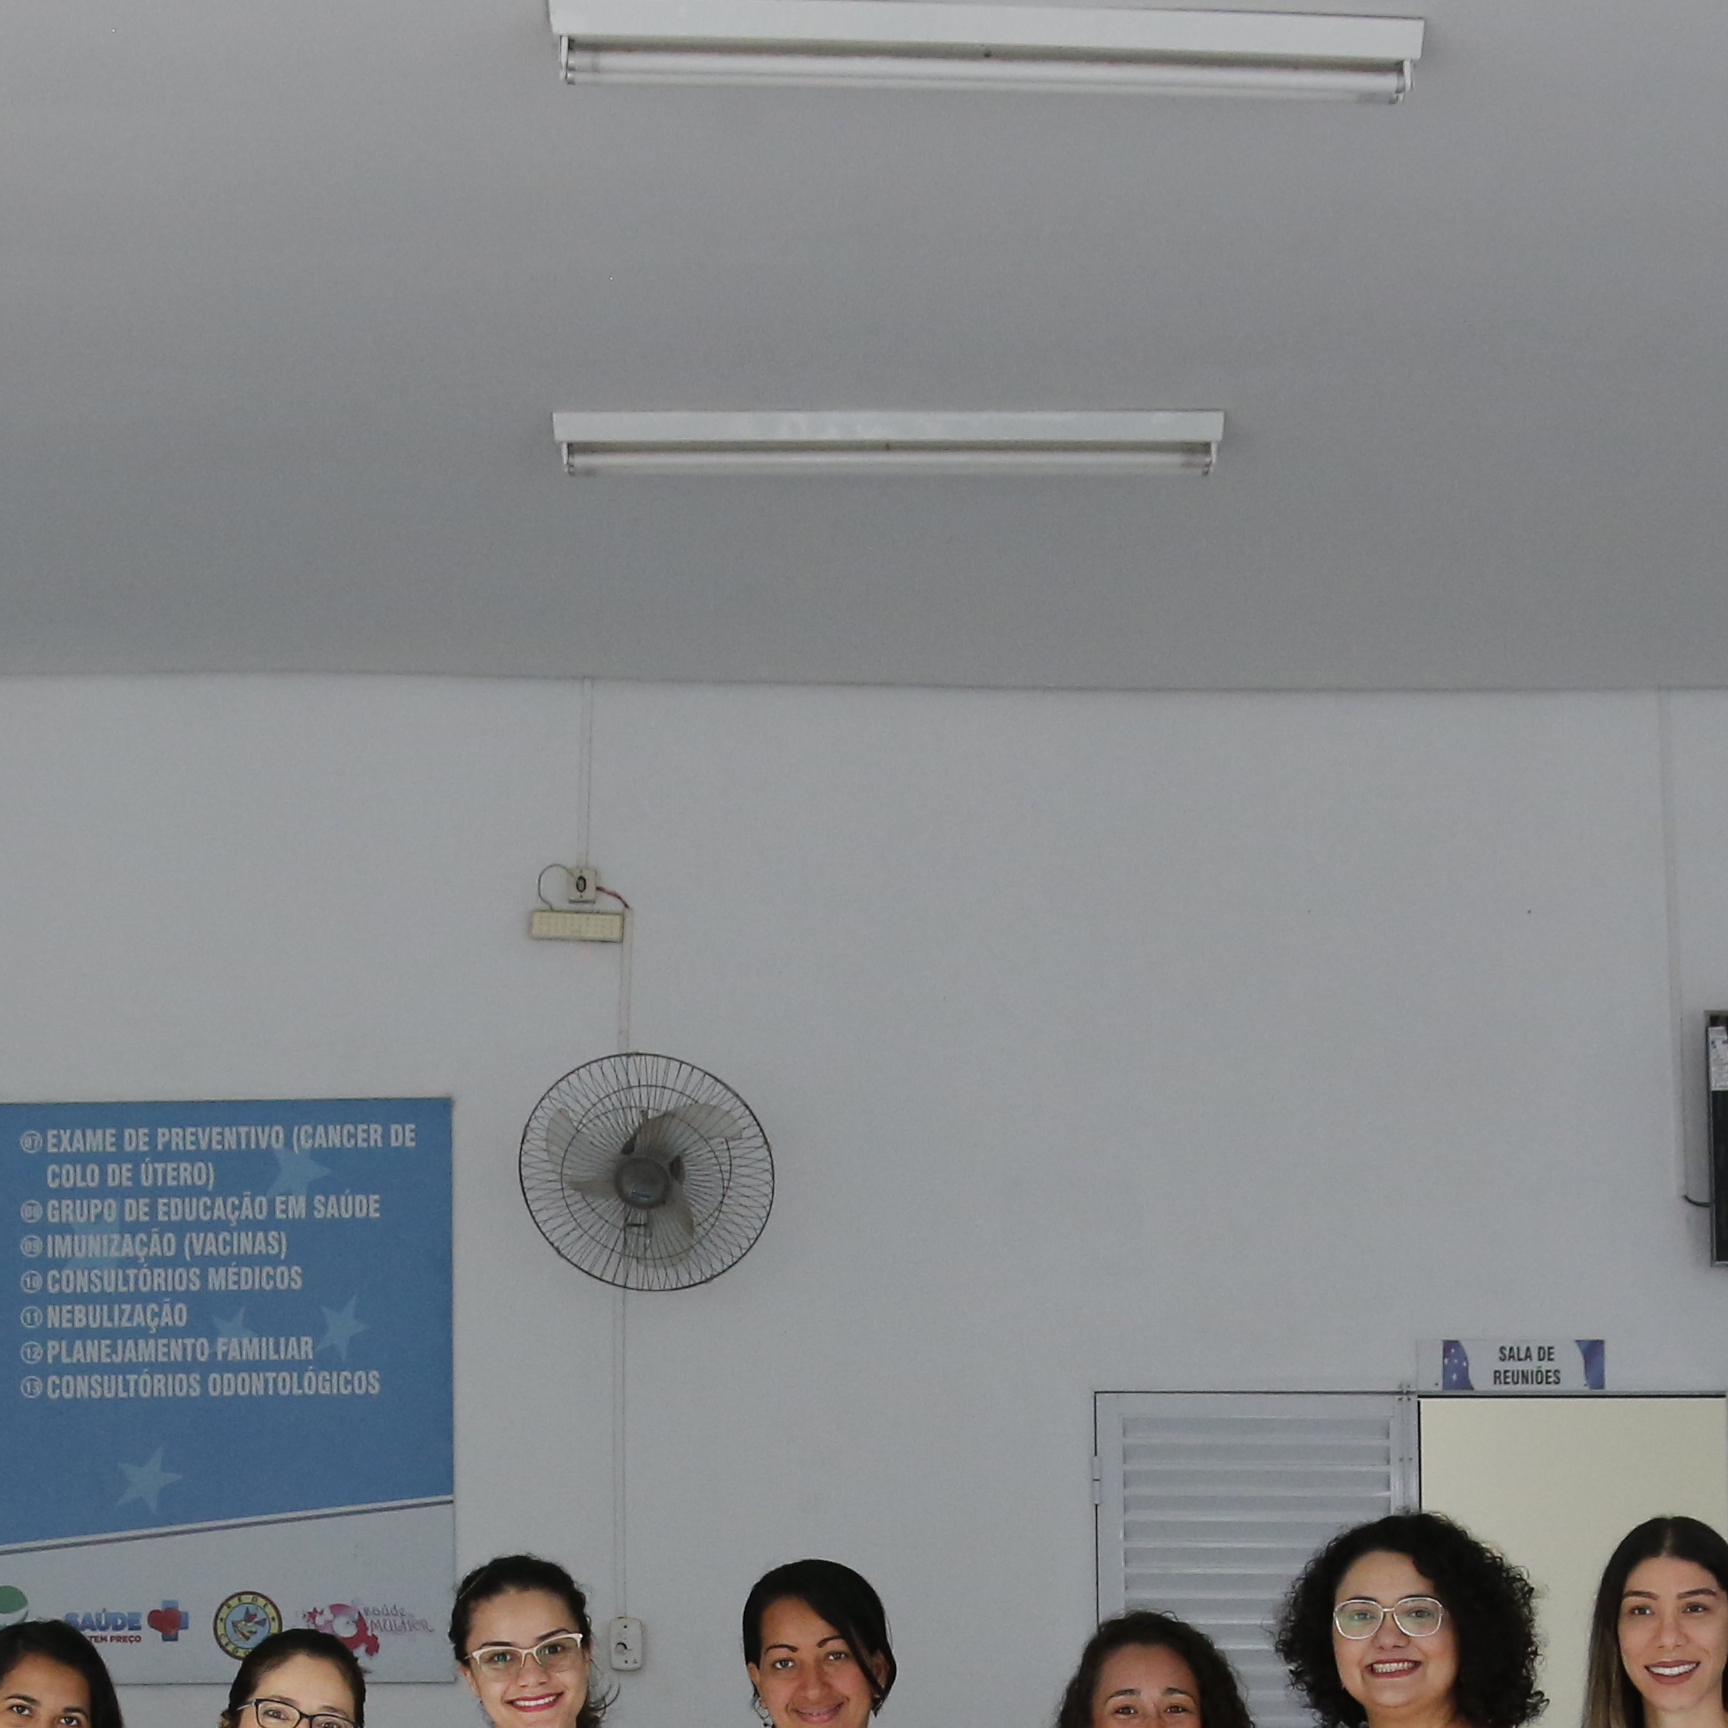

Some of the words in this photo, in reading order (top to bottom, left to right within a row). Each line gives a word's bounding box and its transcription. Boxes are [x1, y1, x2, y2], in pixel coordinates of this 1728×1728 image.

[47, 1128, 116, 1153] EXAME
[125, 1127, 149, 1151] DE
[157, 1125, 284, 1151] PREVENTIVO
[293, 1124, 382, 1154] (CANCER
[390, 1124, 416, 1148] DE
[47, 1163, 99, 1188] COLO
[107, 1163, 132, 1187] DE
[140, 1158, 215, 1190] ÚTERO)
[47, 1198, 116, 1223] GRUPO
[125, 1198, 149, 1222] DE
[157, 1192, 268, 1226] EDUCAÇÃO
[276, 1196, 305, 1219] EM
[313, 1189, 380, 1219] SAÚDE
[47, 1229, 176, 1263] IMUNIZAÇÃO
[184, 1231, 287, 1261] (VACINAS)
[47, 1263, 200, 1293] CONSULTÓRIOS
[208, 1261, 302, 1290] MÉDICOS
[22, 1308, 41, 1326] 11
[47, 1300, 187, 1333] NEBULIZAÇÃO
[22, 1344, 41, 1362] 12
[47, 1338, 210, 1364] PLANEJAMENTO
[217, 1336, 313, 1361] FAMILIAR
[1498, 1346, 1532, 1362] SALA
[1538, 1346, 1554, 1361] DE
[47, 1371, 200, 1399] CONSULTÓRIOS
[208, 1366, 380, 1396] ODONTOLÓGICOS
[1493, 1366, 1561, 1386] REUNIÕES
[65, 1608, 142, 1631] SAÚDE
[110, 1635, 142, 1645] PREÇO
